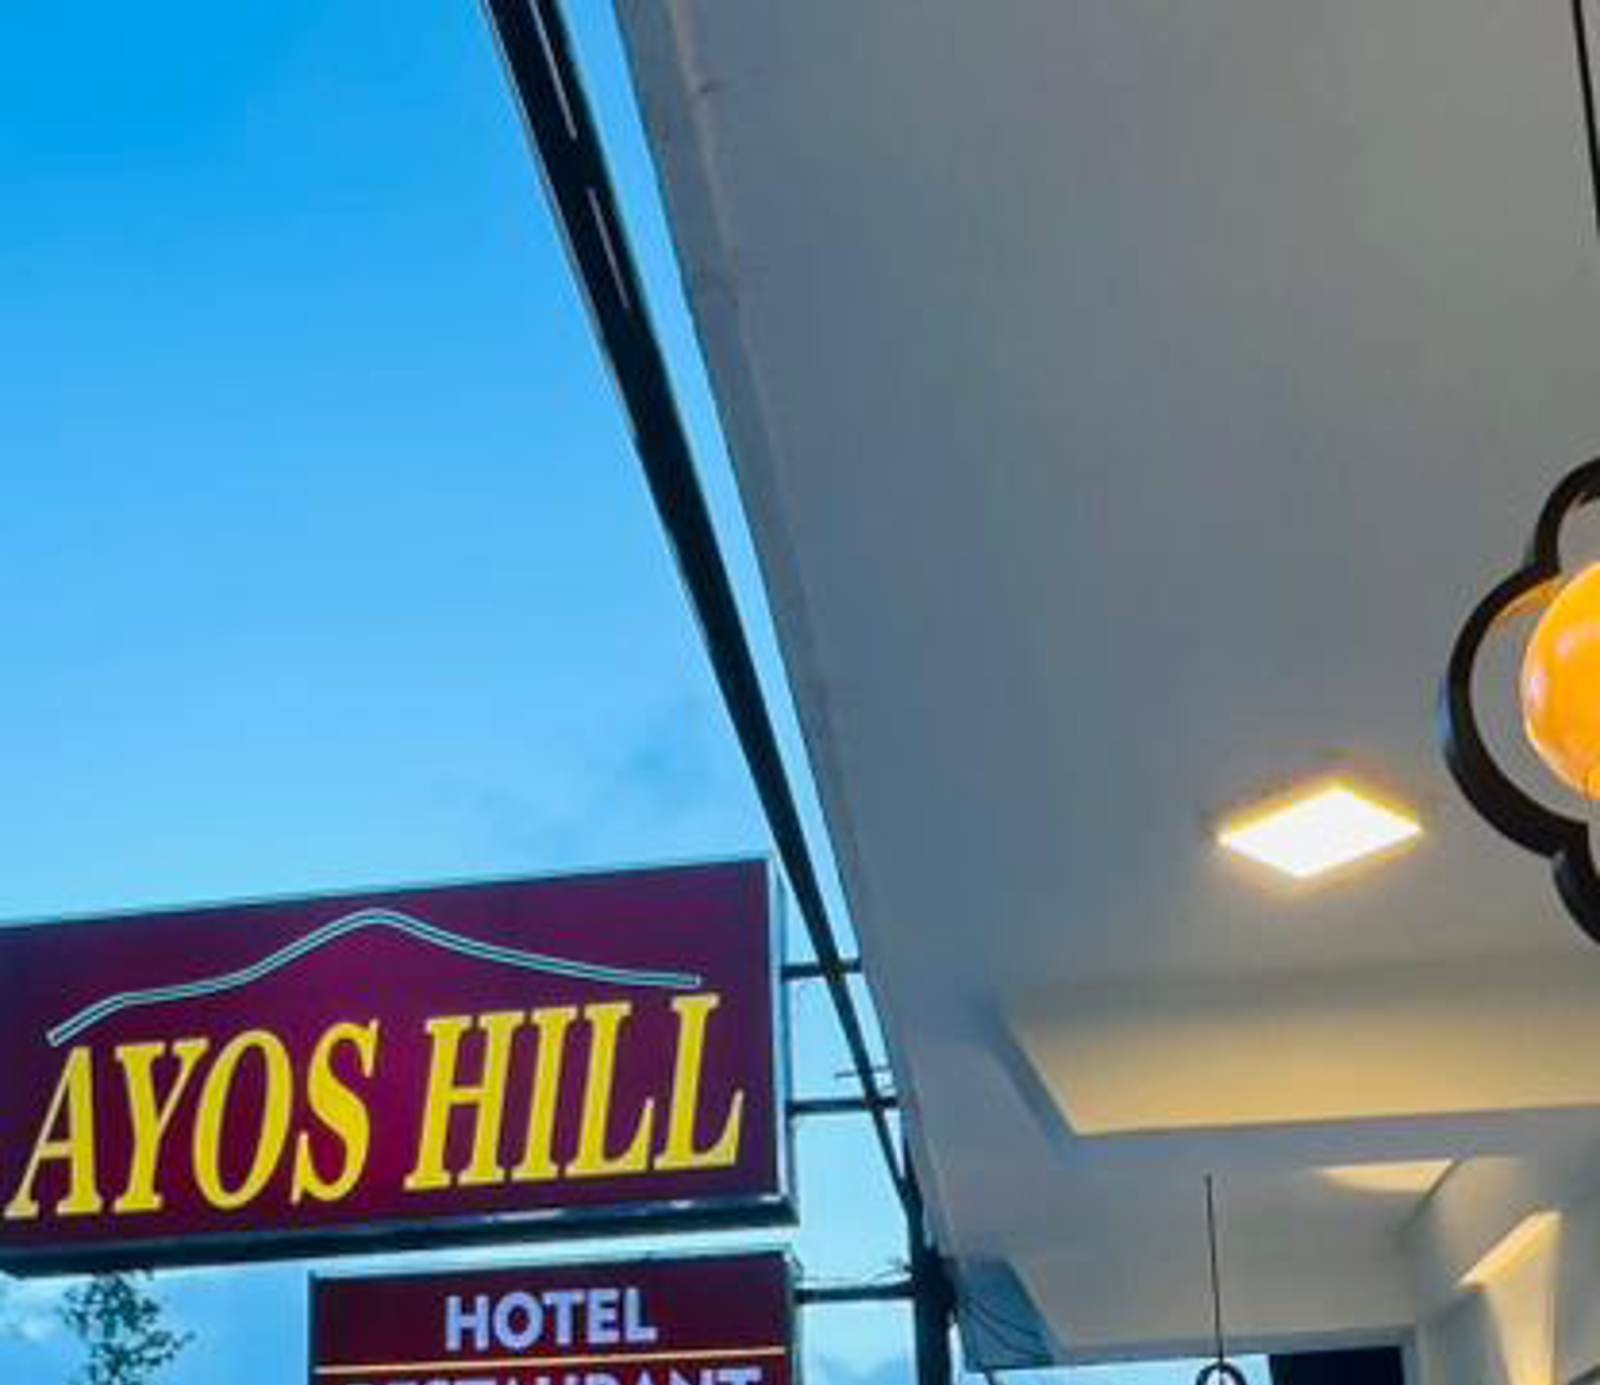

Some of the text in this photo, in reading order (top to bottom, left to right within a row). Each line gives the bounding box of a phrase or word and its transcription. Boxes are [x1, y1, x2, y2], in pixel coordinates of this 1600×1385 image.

[3, 993, 744, 1220] AYOS HILL
[445, 1288, 657, 1351] HOTEL
